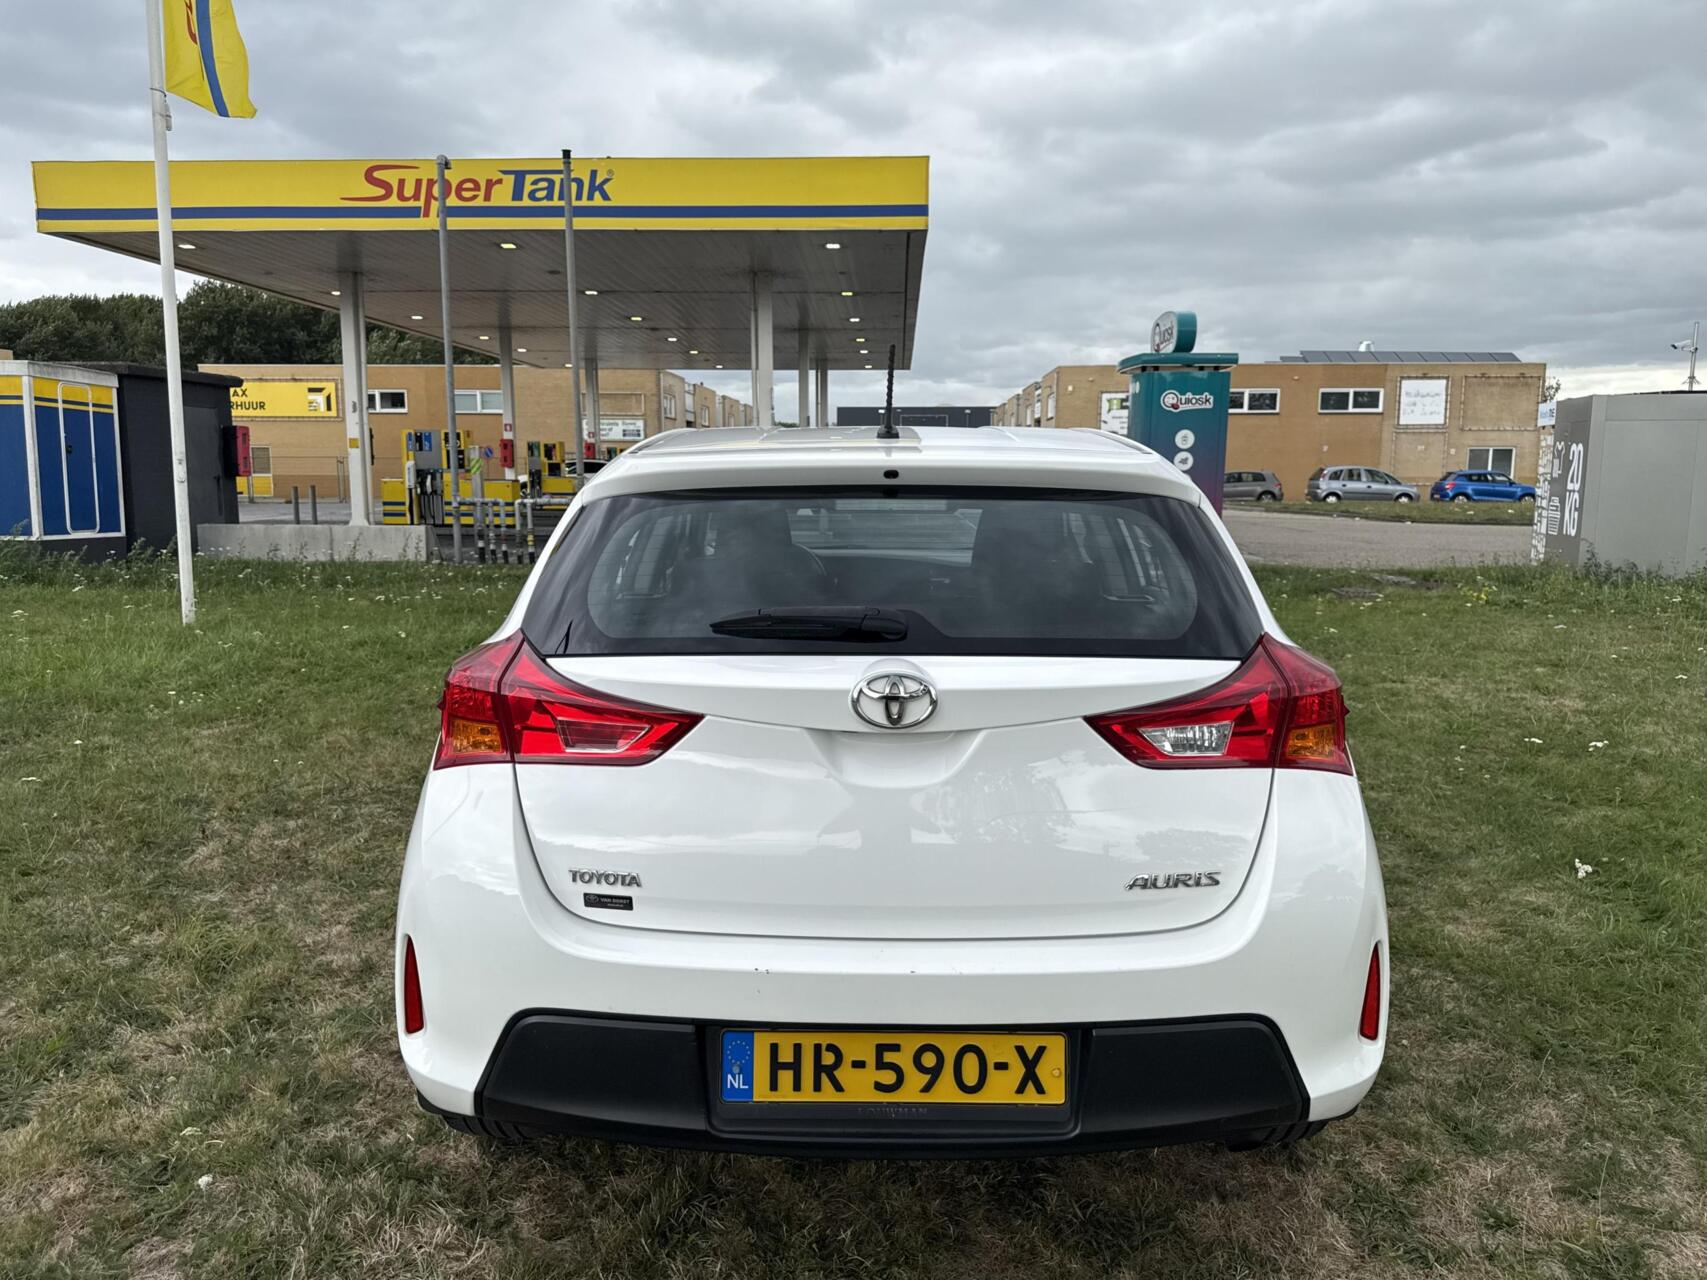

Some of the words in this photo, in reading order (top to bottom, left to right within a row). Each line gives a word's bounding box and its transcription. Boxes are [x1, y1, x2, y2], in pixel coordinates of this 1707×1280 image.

[1161, 391, 1212, 411] Quiosk
[1566, 442, 1584, 492] 20
[1563, 491, 1580, 537] KG
[568, 869, 642, 887] TOYOTA
[727, 1073, 749, 1089] NL
[768, 1042, 1048, 1095] HR-590-X
